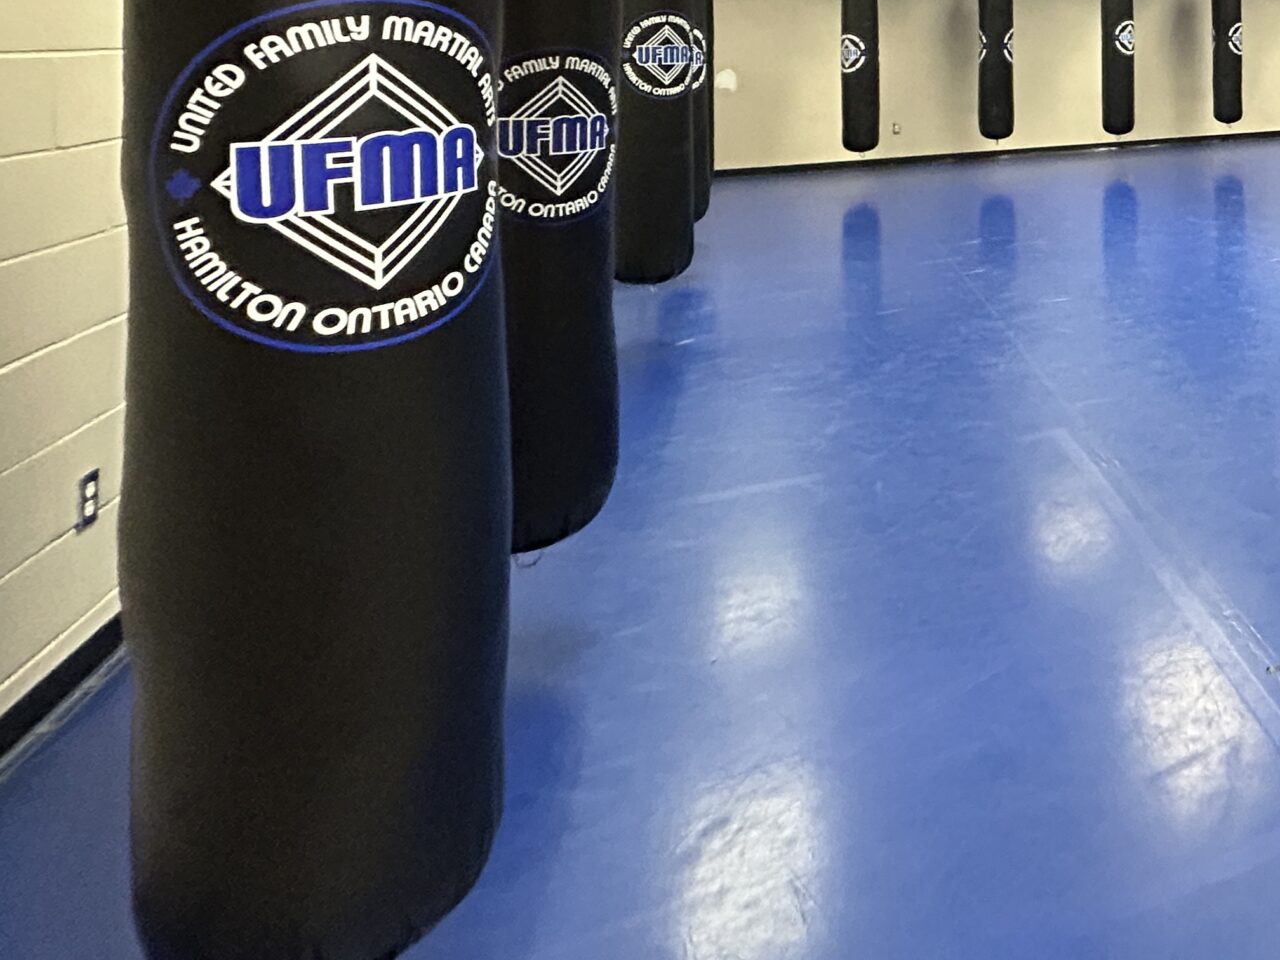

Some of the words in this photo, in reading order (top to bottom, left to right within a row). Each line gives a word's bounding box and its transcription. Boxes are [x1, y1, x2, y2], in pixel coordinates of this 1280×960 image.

[504, 56, 560, 82] FAMILY
[565, 57, 611, 89] MARTIAL
[636, 44, 690, 66] UFMA
[170, 63, 246, 153] UNITED
[243, 15, 370, 70] FAMILY
[382, 15, 481, 77] MARTIAL
[478, 73, 497, 127] ARTS
[497, 113, 606, 158] UFMA
[229, 123, 478, 224] UFMA
[528, 191, 598, 218] ONTARIO
[174, 217, 306, 331] HAMILTON
[312, 271, 464, 335] ONTARIO
[464, 180, 497, 273] CANADA
